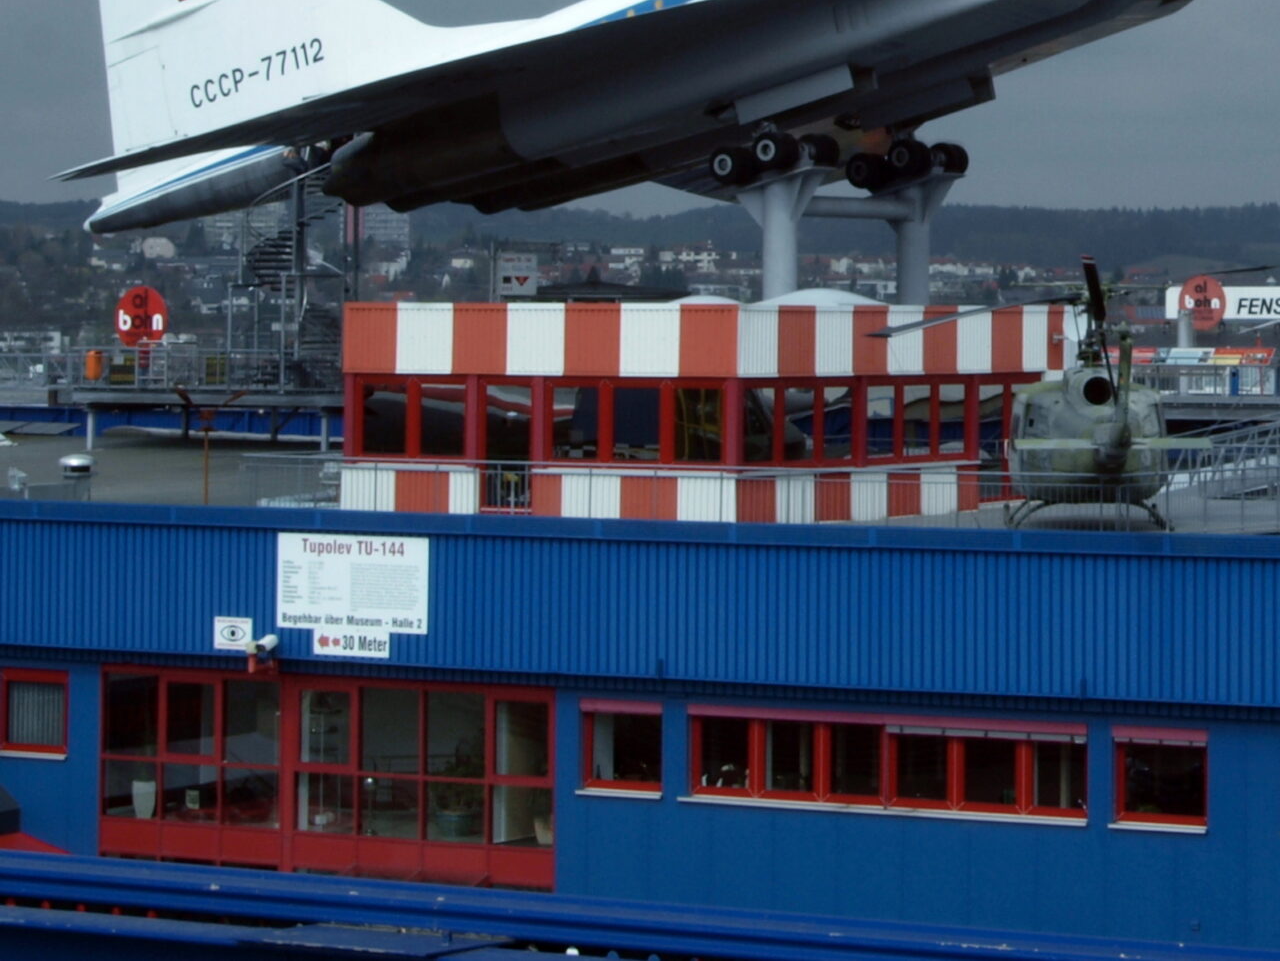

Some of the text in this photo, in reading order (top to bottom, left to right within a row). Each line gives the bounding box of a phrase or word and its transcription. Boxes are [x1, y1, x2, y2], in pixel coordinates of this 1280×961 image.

[301, 538, 405, 557] Tupolev TU-144
[282, 612, 322, 626] Begehbar
[324, 613, 343, 626] über
[346, 615, 383, 627] Museum
[392, 617, 414, 629] Halle
[416, 618, 423, 629] 2
[342, 635, 388, 652] 30 Meter
